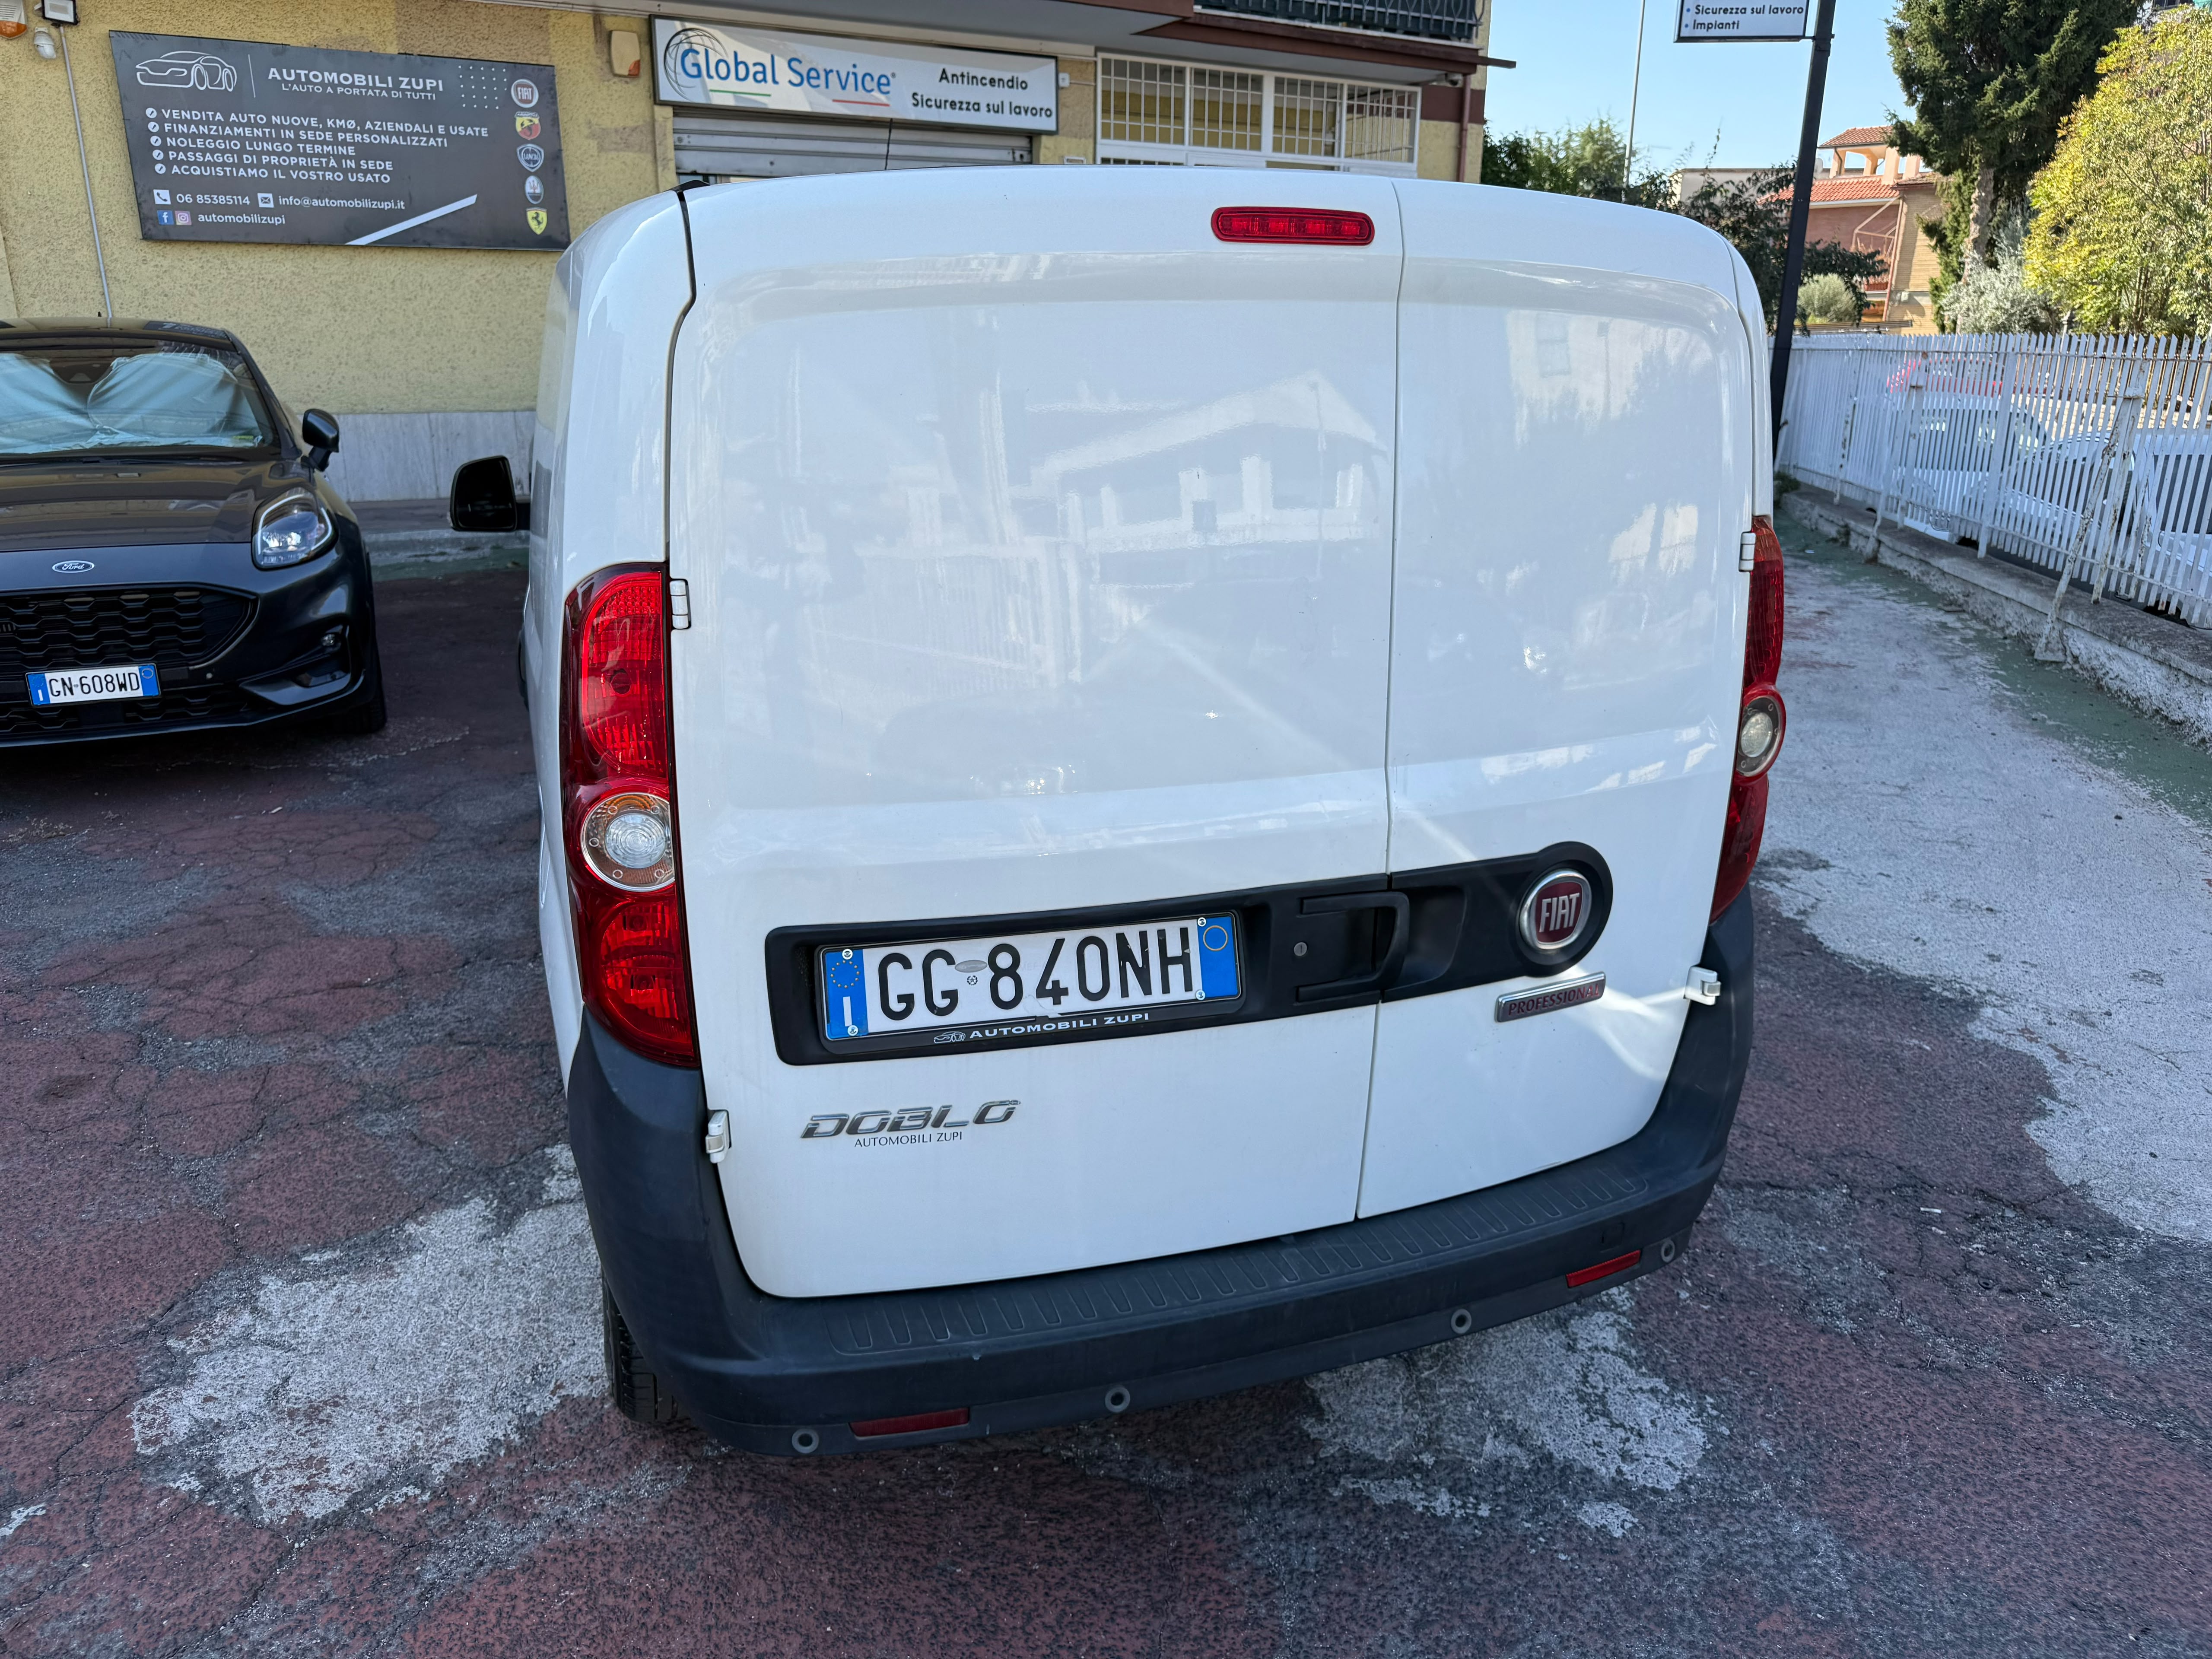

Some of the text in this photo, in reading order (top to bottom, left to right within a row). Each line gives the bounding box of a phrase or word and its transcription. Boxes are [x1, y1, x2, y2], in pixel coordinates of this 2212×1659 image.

[1695, 4, 1804, 15] Sicurezza sul lavoro
[1693, 19, 1740, 32] Impianti
[680, 48, 779, 85] Global
[268, 68, 443, 91] AUTOMOBILI ZUPI
[939, 68, 1028, 90] Antincendio
[282, 83, 322, 93] L'AUTO
[337, 87, 388, 97] PORTATA
[391, 90, 402, 99] DI
[407, 91, 436, 100] TUTTI
[518, 87, 533, 100] FIAT
[912, 92, 1052, 118] Sicurezza sul lavoro
[161, 109, 224, 122] VENDITA
[229, 113, 267, 124] AUTO
[272, 115, 322, 128] NUOVE,
[365, 121, 433, 134] AZIENDALI
[438, 125, 445, 134] E
[449, 126, 489, 137] USATE
[164, 123, 448, 147] FINANZIAMENTI IN SEDE PERSONALIZZATI
[167, 137, 356, 156] NOLEGGIO LUNGO TERMINE
[169, 151, 393, 171] PASSAGGI DI PROPRIETÀ IN SEDE
[172, 165, 391, 183] ACQUISTIAMO IL VOSTRO USATO
[176, 194, 405, 210] 06 85385114 info@automobilizupi.it
[198, 213, 285, 226] automobilizupi
[62, 563, 85, 571] Ford
[1539, 893, 1580, 933] FIAT
[1508, 983, 1600, 1016] PROFESSIONAL
[969, 1013, 1149, 1039] AUTOMOBILI ZUPI
[854, 1131, 963, 1147] AUTOMOBILI ZUPI
